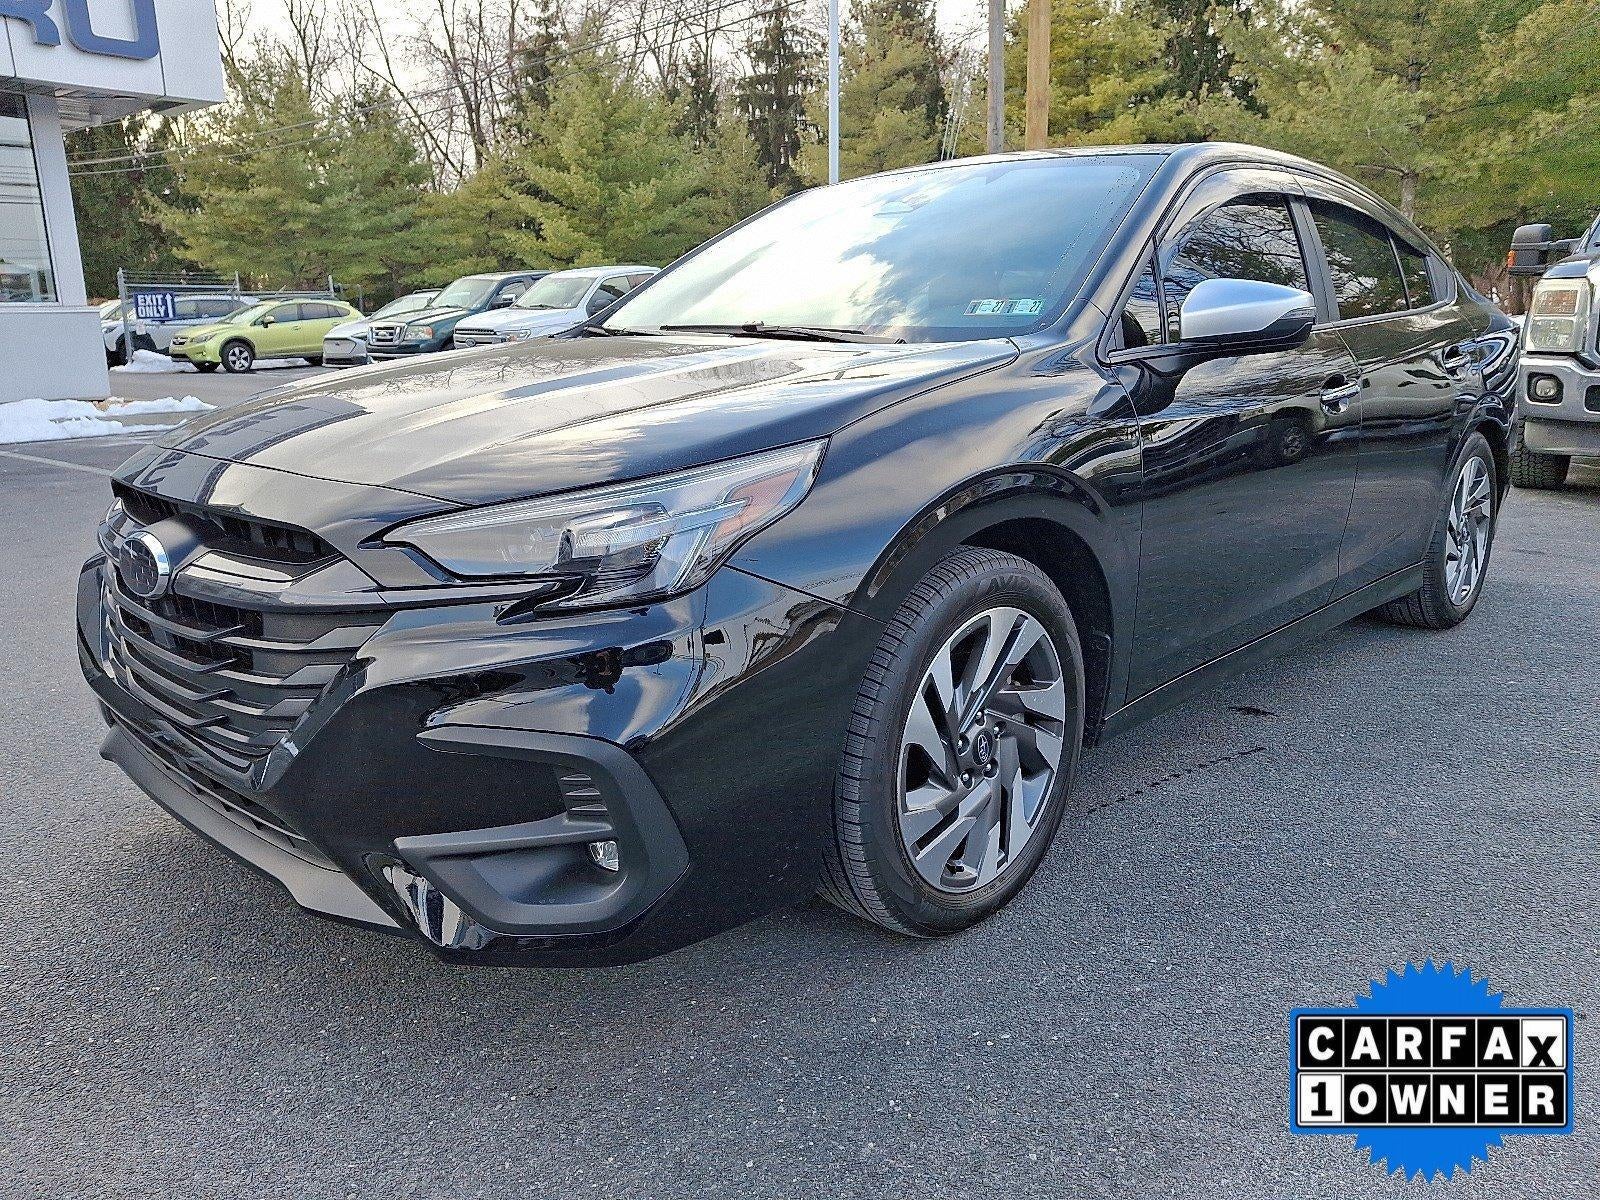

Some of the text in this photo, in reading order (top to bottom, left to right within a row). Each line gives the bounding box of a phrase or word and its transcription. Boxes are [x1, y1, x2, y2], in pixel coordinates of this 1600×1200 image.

[137, 294, 164, 306] EXIT
[137, 305, 166, 318] ONLY
[991, 301, 1004, 313] 27
[1029, 301, 1042, 313] 27
